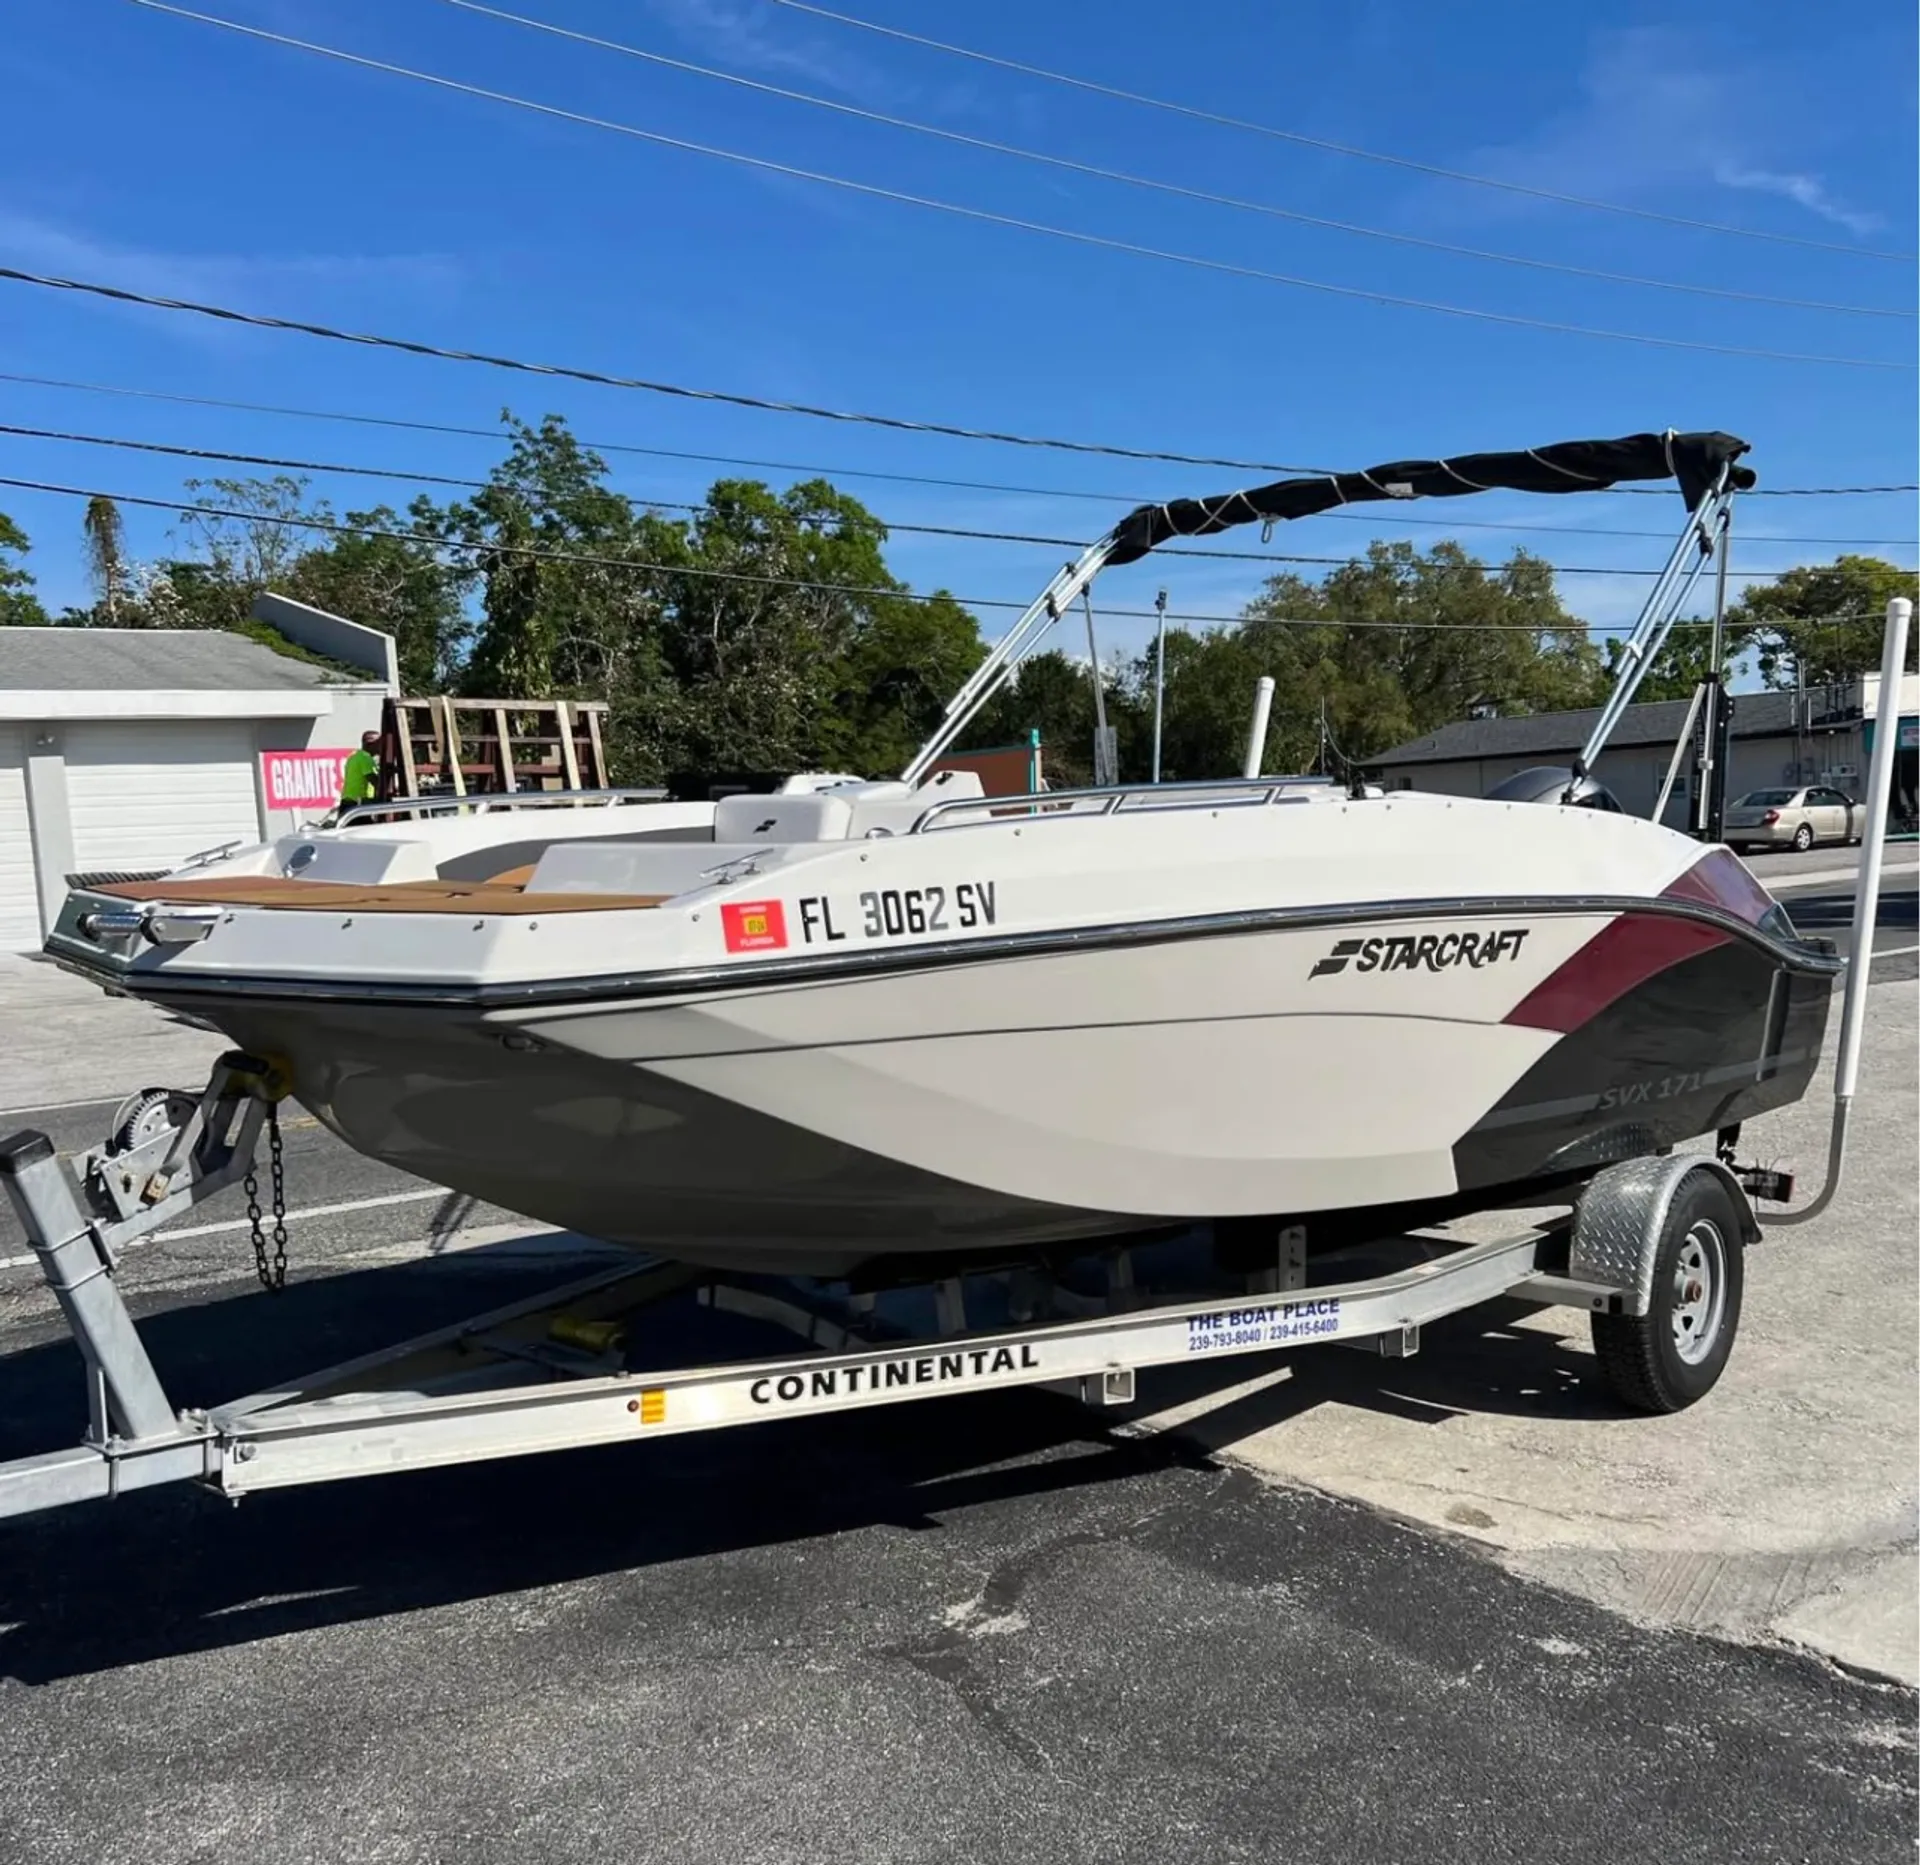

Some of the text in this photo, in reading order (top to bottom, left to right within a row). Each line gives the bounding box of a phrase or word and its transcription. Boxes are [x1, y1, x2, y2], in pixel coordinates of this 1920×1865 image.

[271, 758, 340, 800] GRANITE
[800, 881, 995, 943] FL 3062 SV
[1356, 929, 1530, 972] STARCRAFT
[1600, 1072, 1701, 1110] SVX 171
[1187, 1298, 1340, 1332] THE BOAT PLACE
[1189, 1329, 1261, 1351] 239-793-8040
[1269, 1318, 1339, 1340] 239-415-6400
[750, 1345, 1039, 1404] CONTINENTAL
